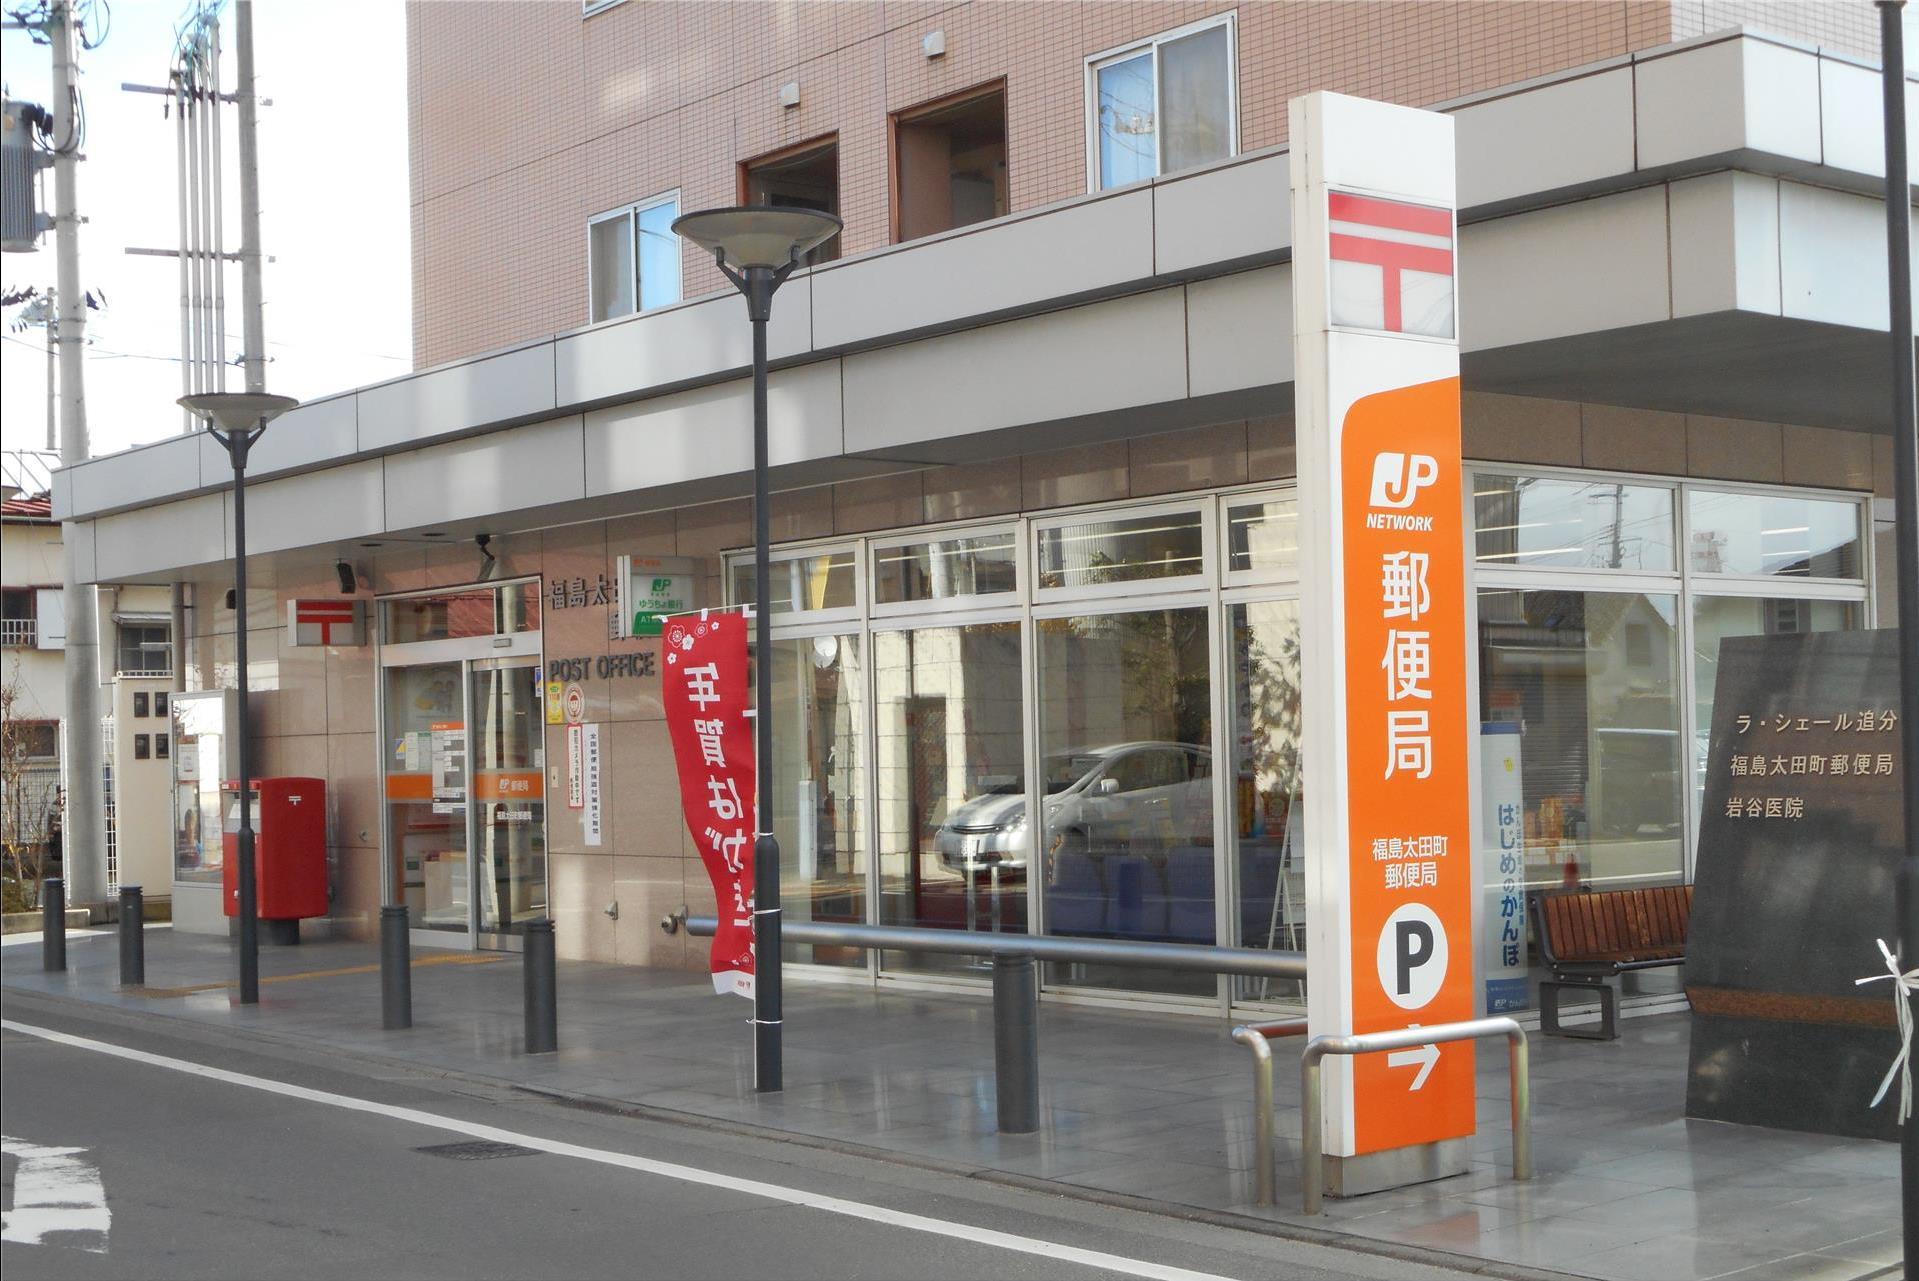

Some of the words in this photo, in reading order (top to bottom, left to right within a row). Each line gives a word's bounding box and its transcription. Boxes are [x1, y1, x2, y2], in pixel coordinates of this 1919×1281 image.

[1369, 452, 1439, 508] JP
[1366, 513, 1433, 531] NETWORK
[551, 573, 618, 610] 福島太
[639, 599, 683, 609] ゆうちょ銀行
[549, 656, 592, 683] POST
[597, 652, 656, 680] OFFICE
[1381, 551, 1434, 780] 郵便局
[1736, 709, 1898, 734] ラ・シェール追分
[1730, 753, 1894, 777] 福島太田町郵便局
[1725, 796, 1804, 819] 岩谷医院
[1372, 834, 1449, 862] 福島太田町
[1385, 861, 1437, 889] 郵便局
[1498, 804, 1520, 967] はじめのかんぽ
[1395, 919, 1434, 995] P
